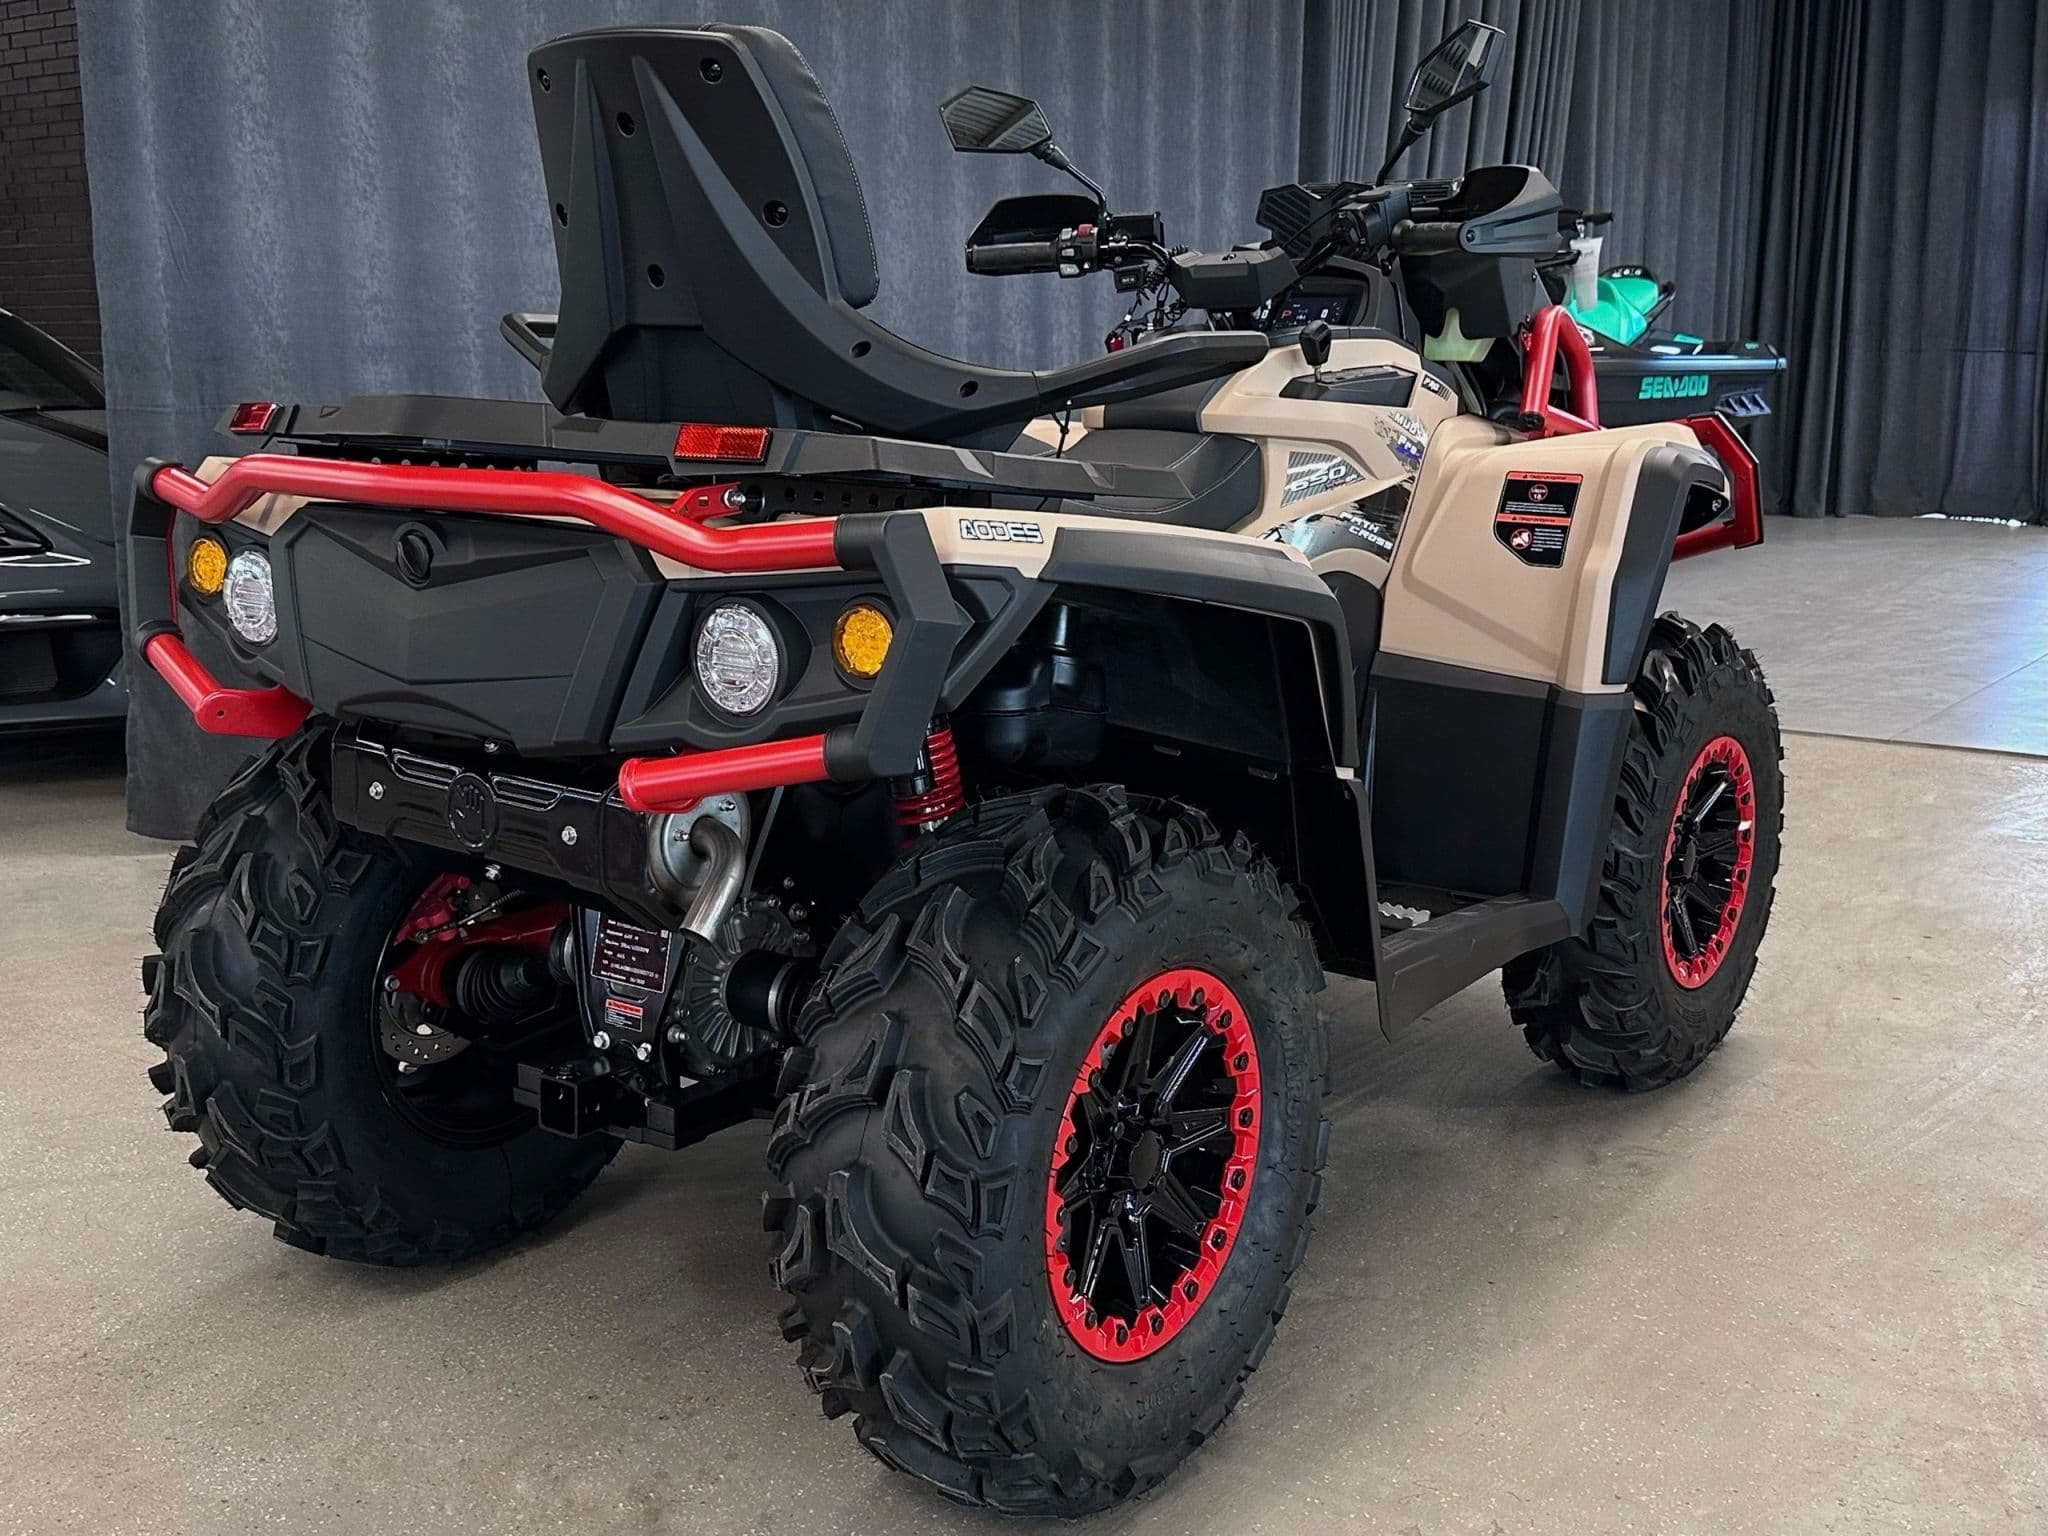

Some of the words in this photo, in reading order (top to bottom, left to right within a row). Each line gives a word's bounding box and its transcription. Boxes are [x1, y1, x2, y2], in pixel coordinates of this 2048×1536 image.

[1395, 412, 1417, 434] MUD
[1287, 465, 1346, 492] 650
[960, 519, 1043, 543] AODES
[1349, 525, 1393, 550] CROSS
